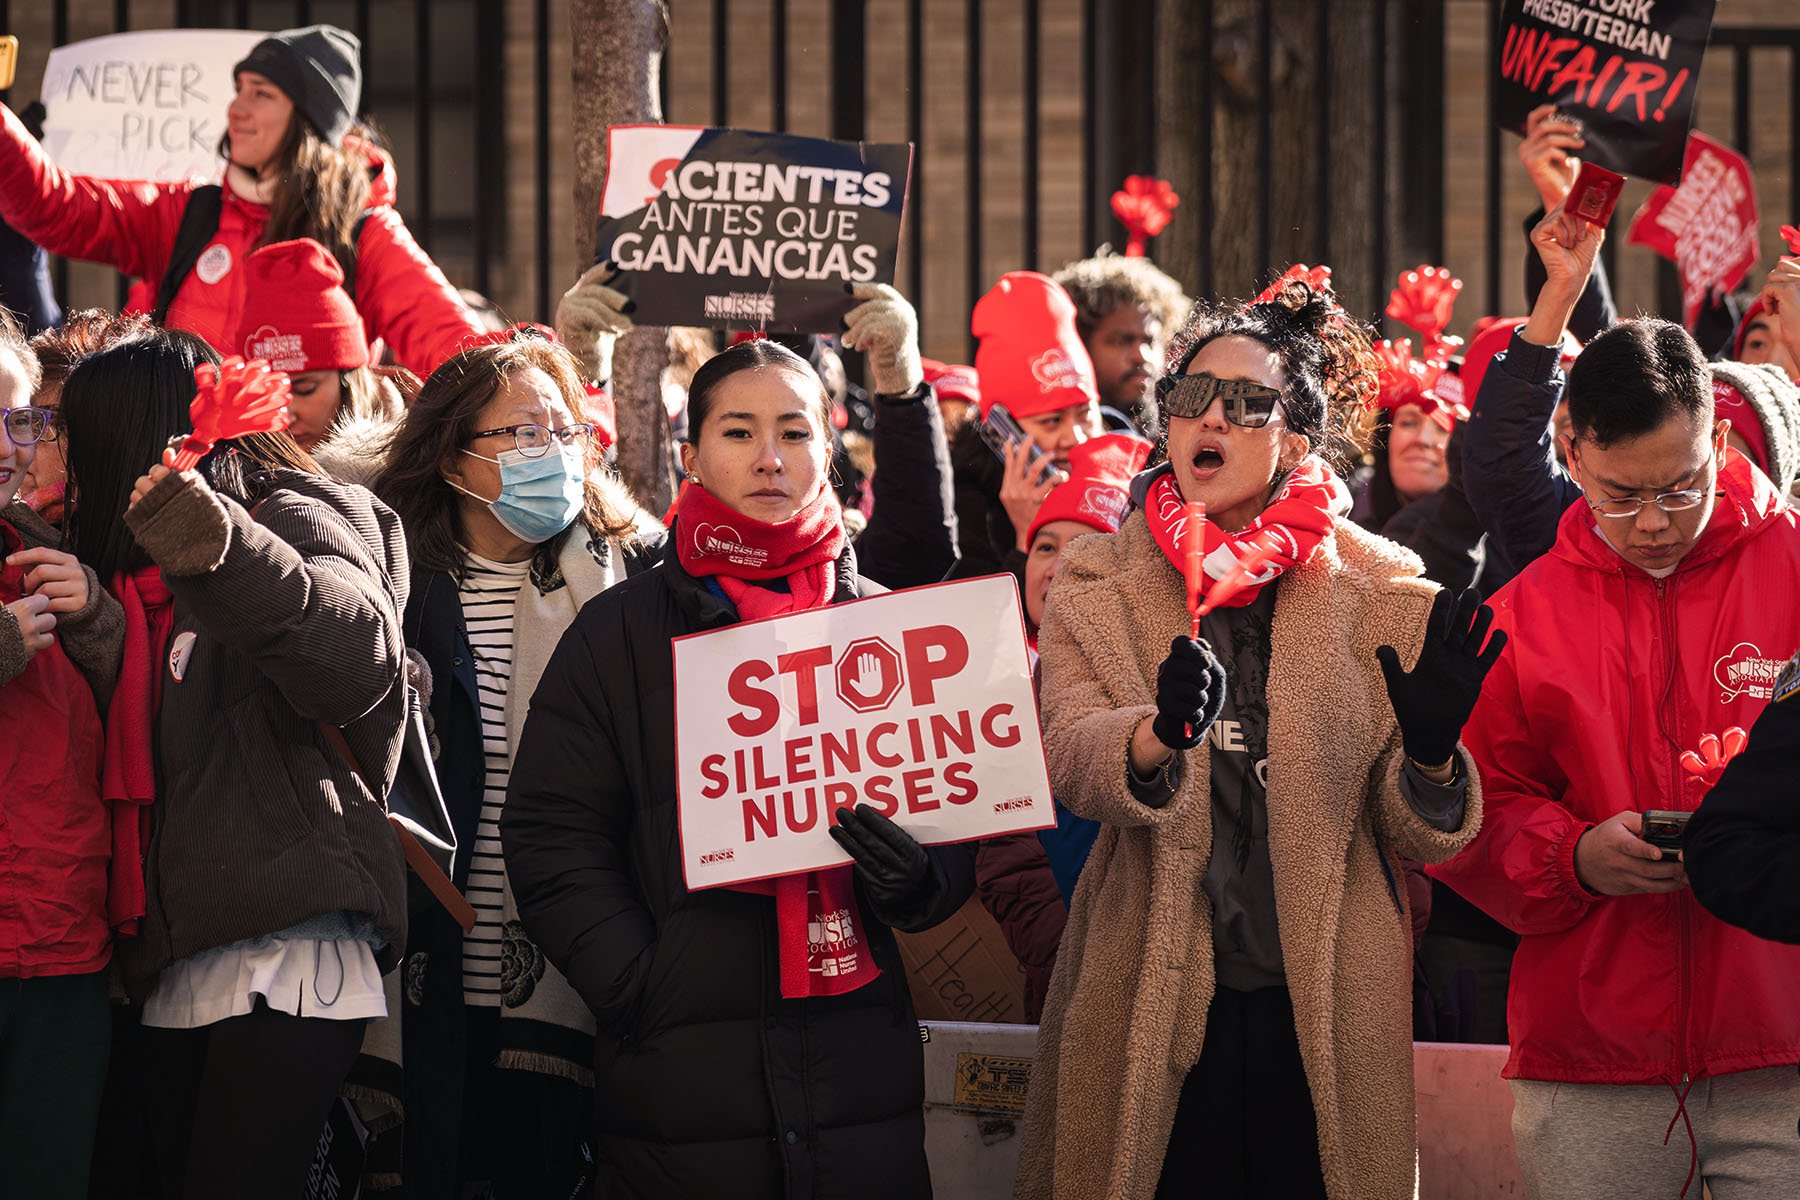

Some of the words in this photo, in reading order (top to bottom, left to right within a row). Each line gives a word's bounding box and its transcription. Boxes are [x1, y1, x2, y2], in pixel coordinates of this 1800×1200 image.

[1522, 0, 1673, 60] PRESBYTERIAN
[1589, 0, 1656, 24] ORK
[67, 60, 209, 108] NEVER
[1502, 22, 1690, 122] UNFAIR!
[121, 112, 212, 153] PICK
[661, 160, 891, 207] ACIENTES
[639, 200, 764, 236] ANTES
[775, 207, 859, 241] QUE
[611, 232, 878, 282] GANANCIAS
[704, 295, 775, 314] NURSES
[726, 624, 969, 737] STOP
[1727, 661, 1785, 681] NURSE
[701, 703, 1022, 799] SILENCING
[742, 762, 979, 842] NURSES
